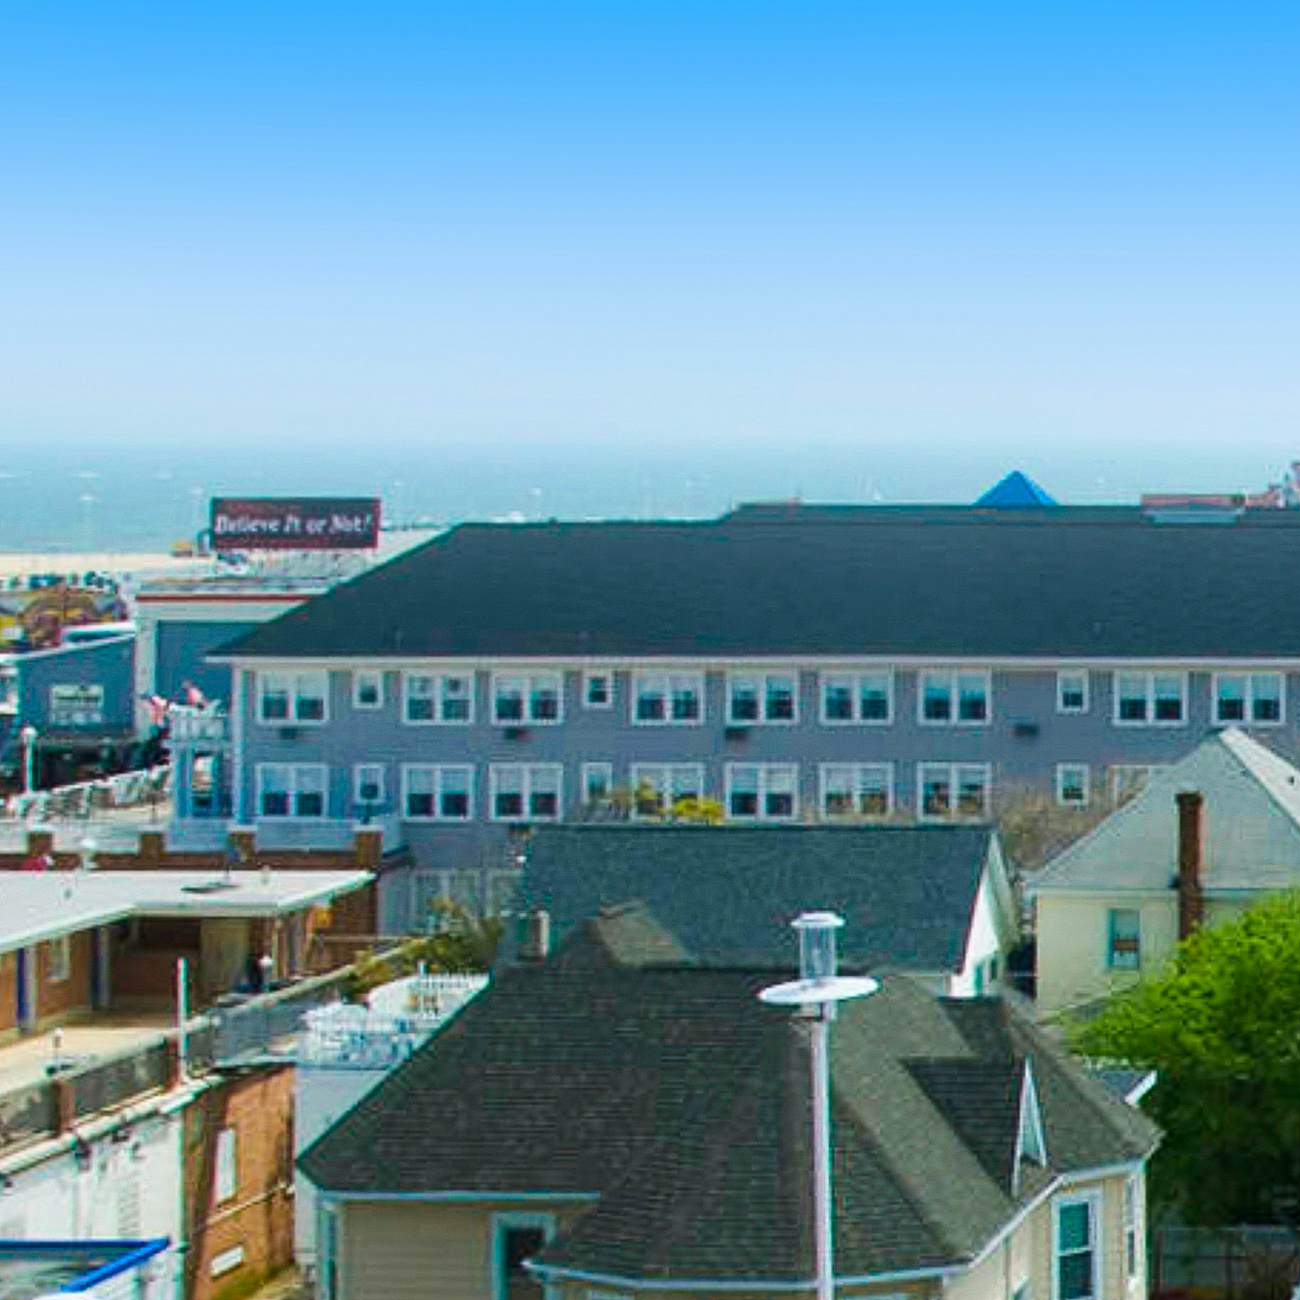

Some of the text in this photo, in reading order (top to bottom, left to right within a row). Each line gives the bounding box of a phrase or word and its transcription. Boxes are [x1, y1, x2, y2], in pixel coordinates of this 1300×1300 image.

[214, 513, 281, 534] Believe
[283, 513, 300, 533] It
[305, 518, 328, 533] or
